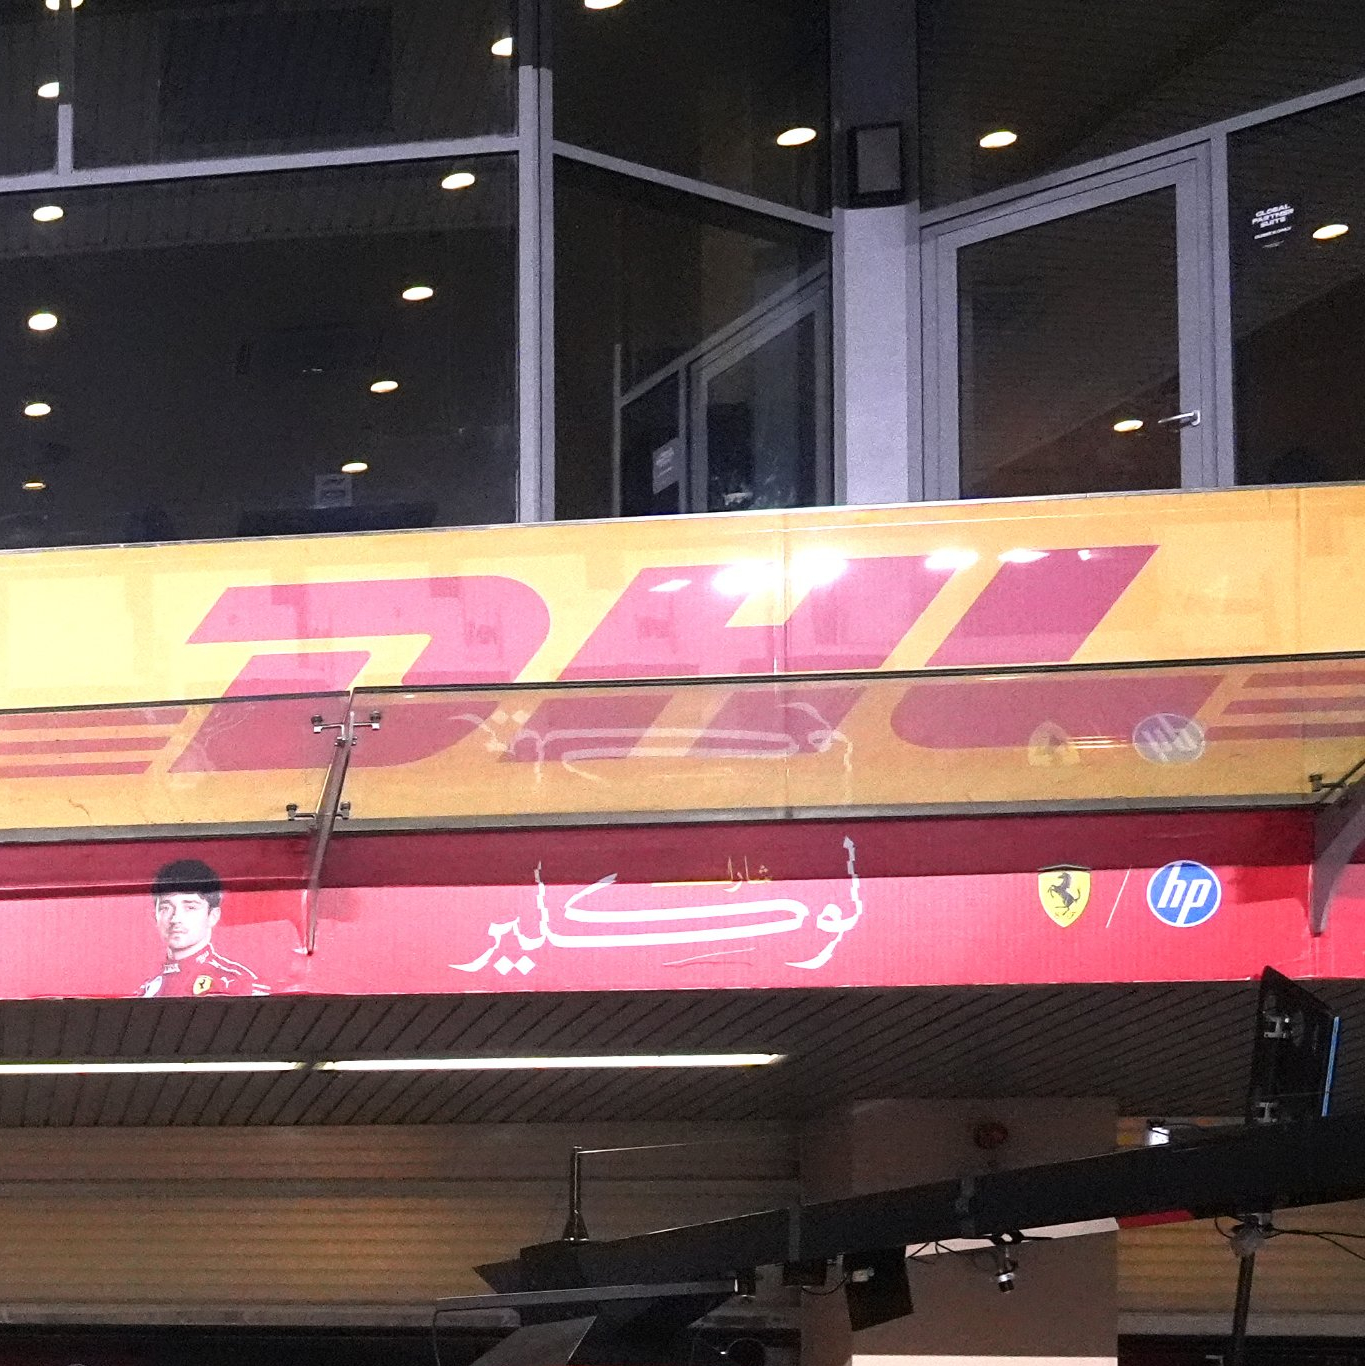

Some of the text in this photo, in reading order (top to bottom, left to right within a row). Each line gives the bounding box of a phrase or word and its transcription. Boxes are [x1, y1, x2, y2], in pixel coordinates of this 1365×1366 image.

[169, 545, 1160, 773] DHL
[448, 835, 863, 976] لوكلير
[1153, 860, 1215, 927] hp
